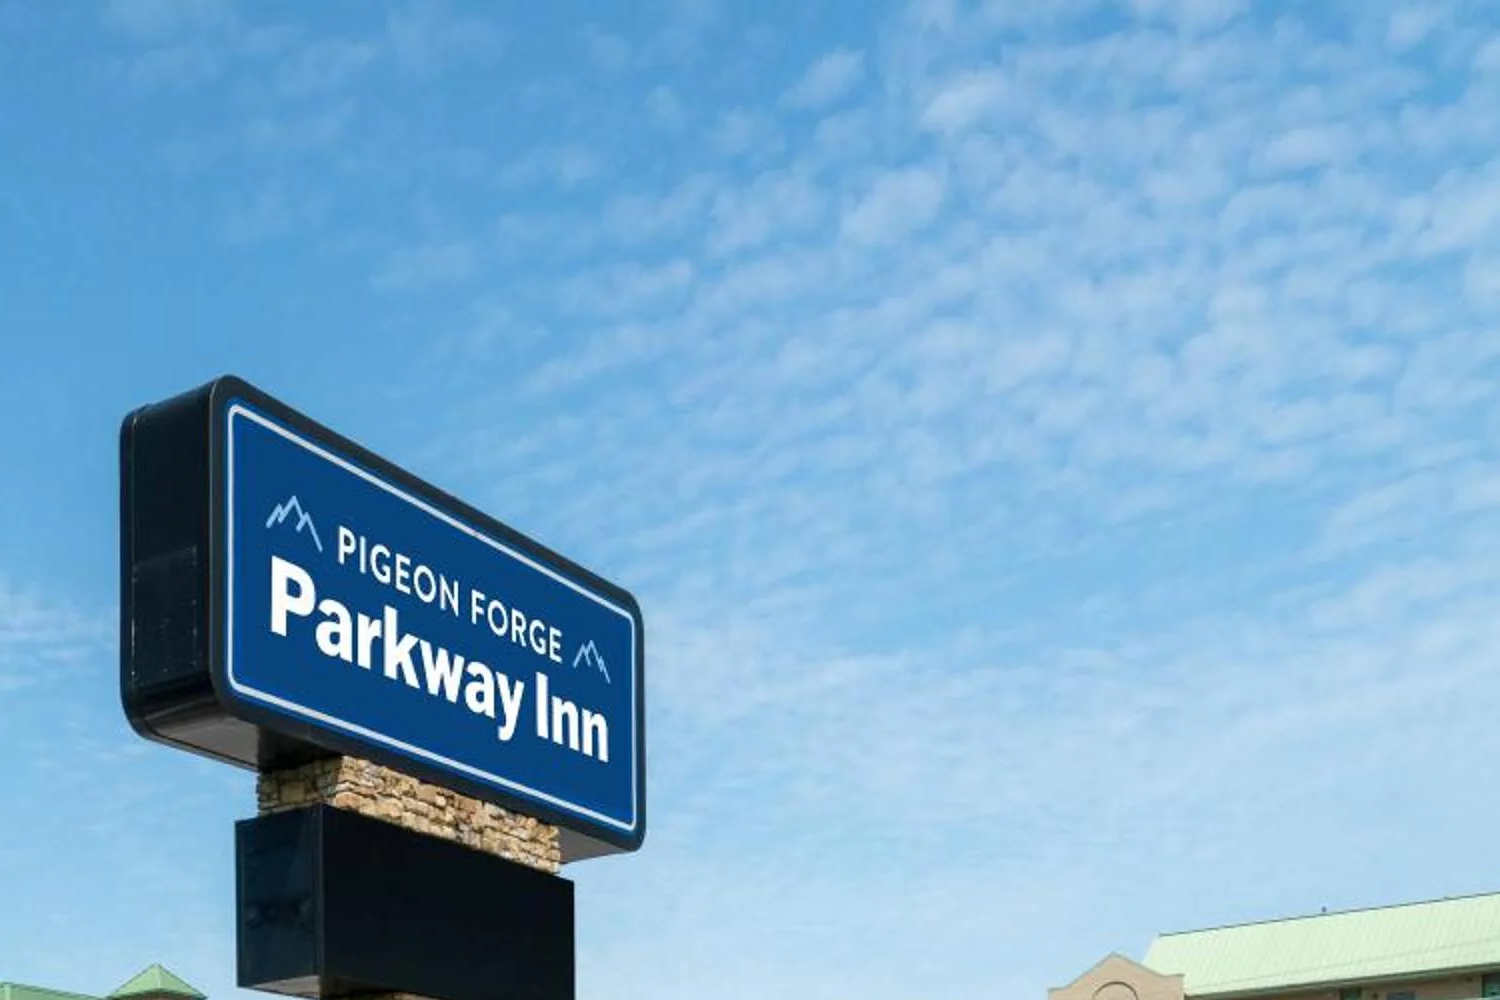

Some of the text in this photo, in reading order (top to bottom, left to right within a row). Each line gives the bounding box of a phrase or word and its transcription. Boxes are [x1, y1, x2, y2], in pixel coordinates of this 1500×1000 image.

[270, 555, 609, 762] Parkway Inn
[338, 526, 563, 663] PIGEON FORGE
